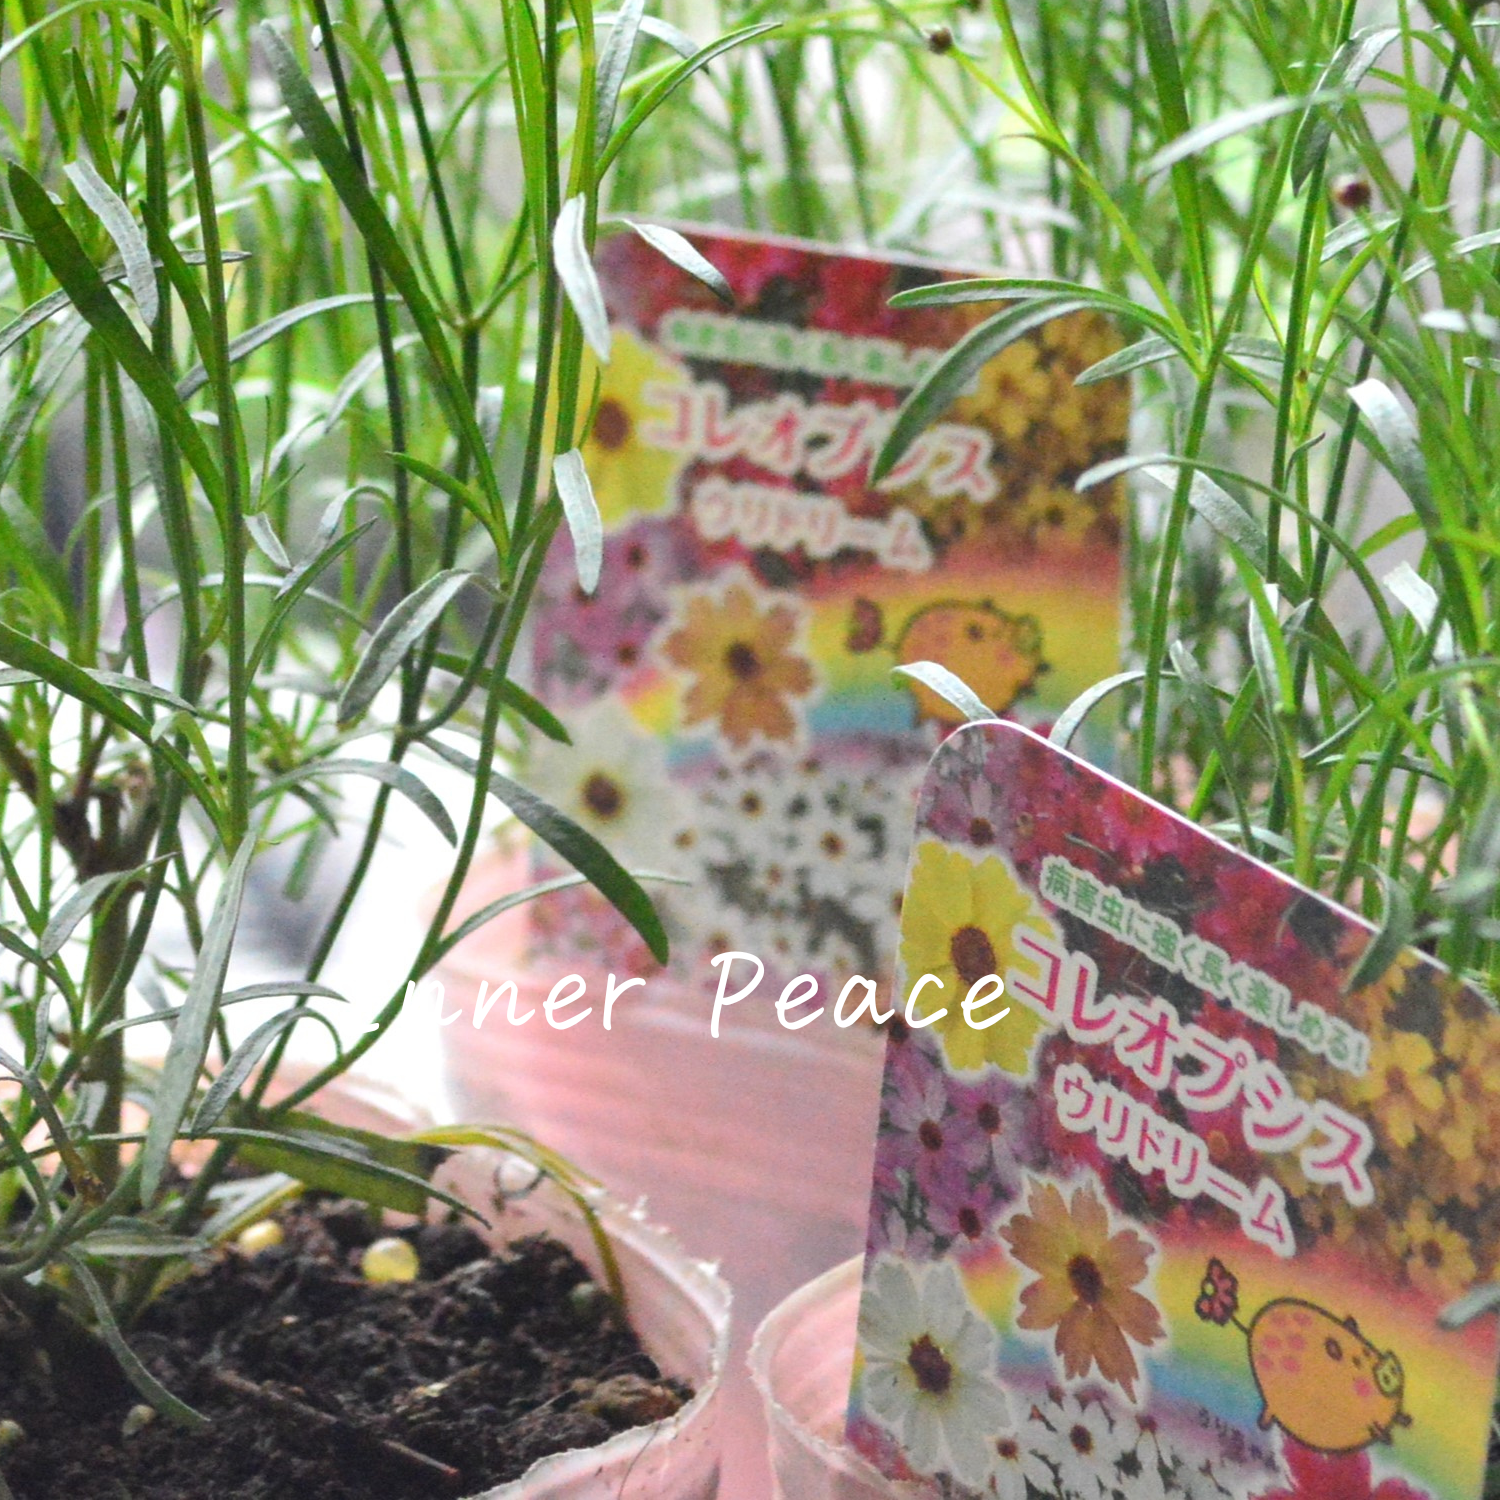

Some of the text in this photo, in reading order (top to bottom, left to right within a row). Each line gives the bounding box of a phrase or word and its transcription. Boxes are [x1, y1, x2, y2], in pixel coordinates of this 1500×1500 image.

[1011, 933, 1365, 1193] コレオプシス
[1061, 1073, 1288, 1246] ウリドリーム
